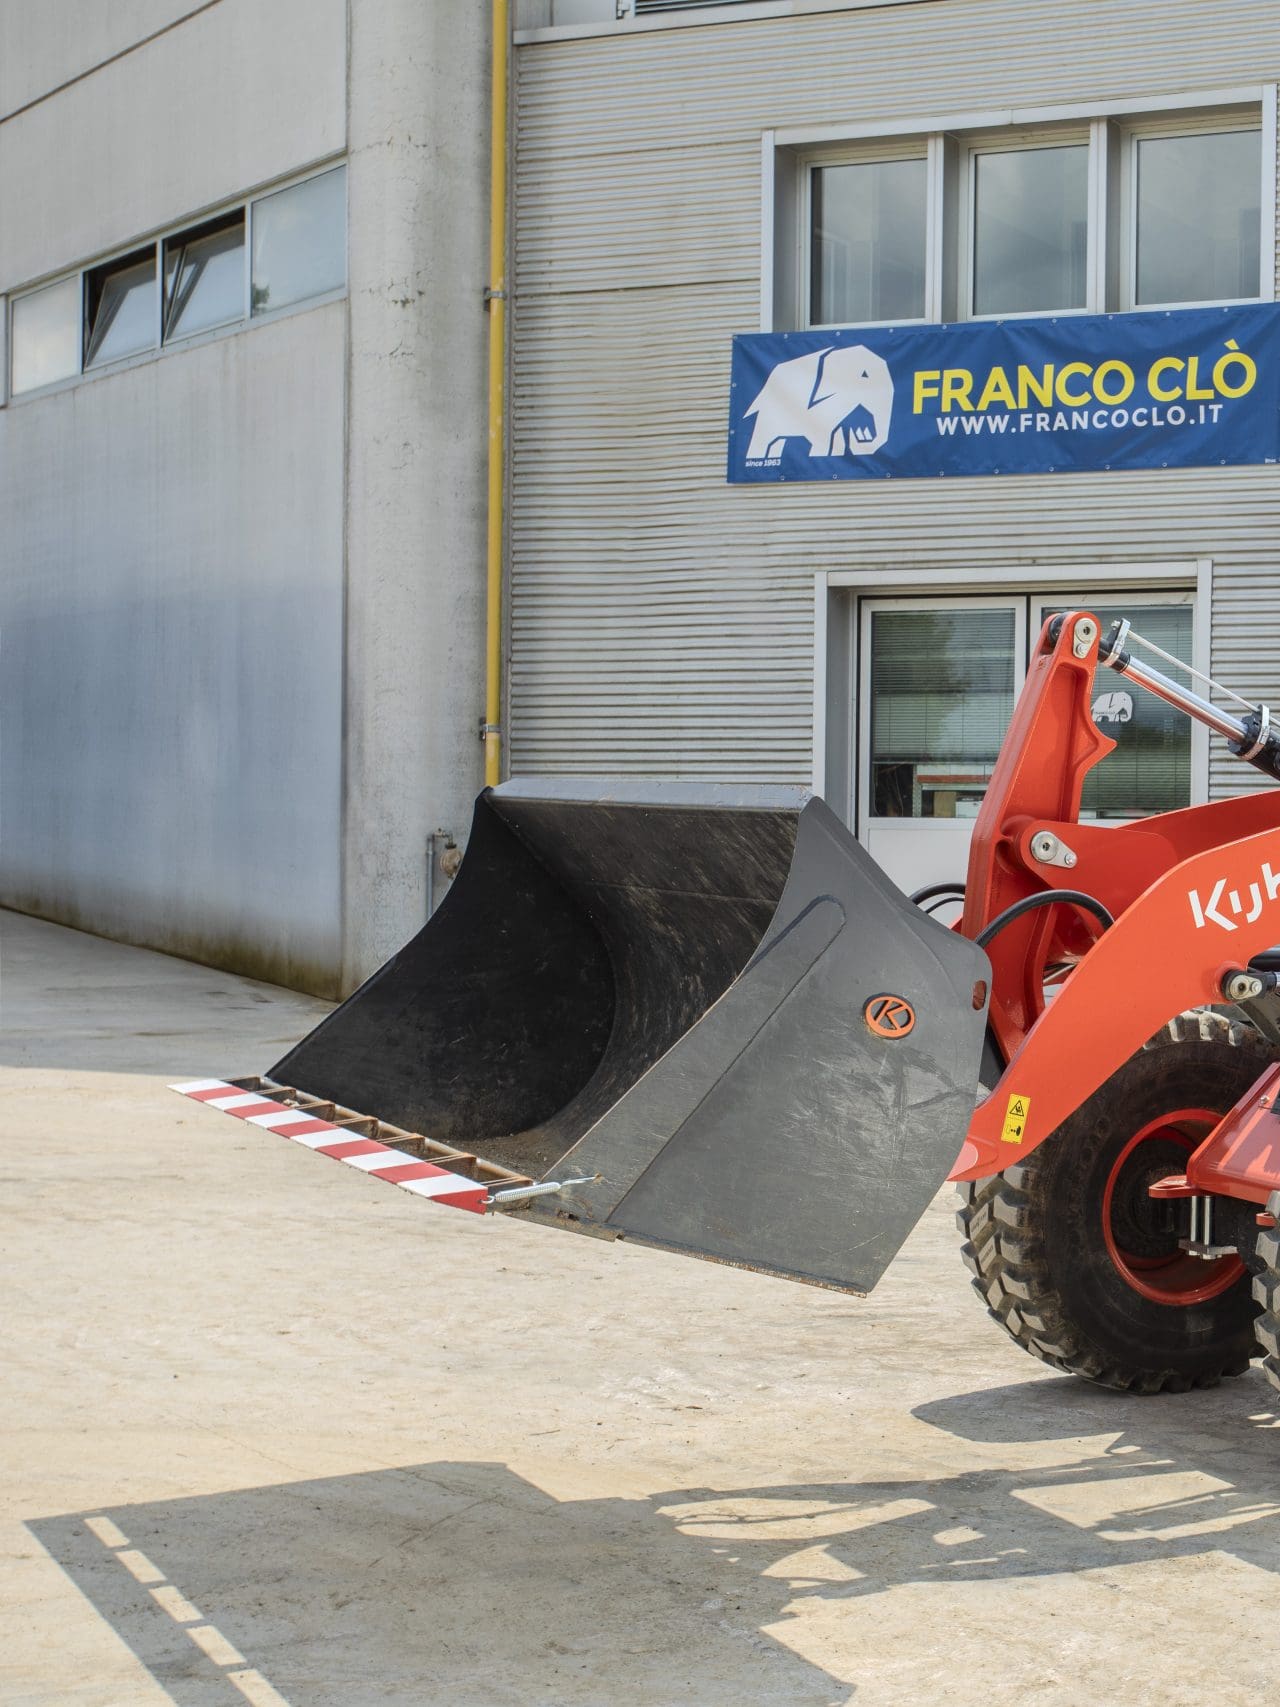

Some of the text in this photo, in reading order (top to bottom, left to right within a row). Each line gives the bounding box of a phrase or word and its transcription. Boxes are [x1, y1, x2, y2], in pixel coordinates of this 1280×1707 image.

[912, 339, 1257, 415] FRANCO CLÒ
[936, 404, 1224, 436] WWW.FRANCOCLO.IT
[764, 459, 781, 467] 1963
